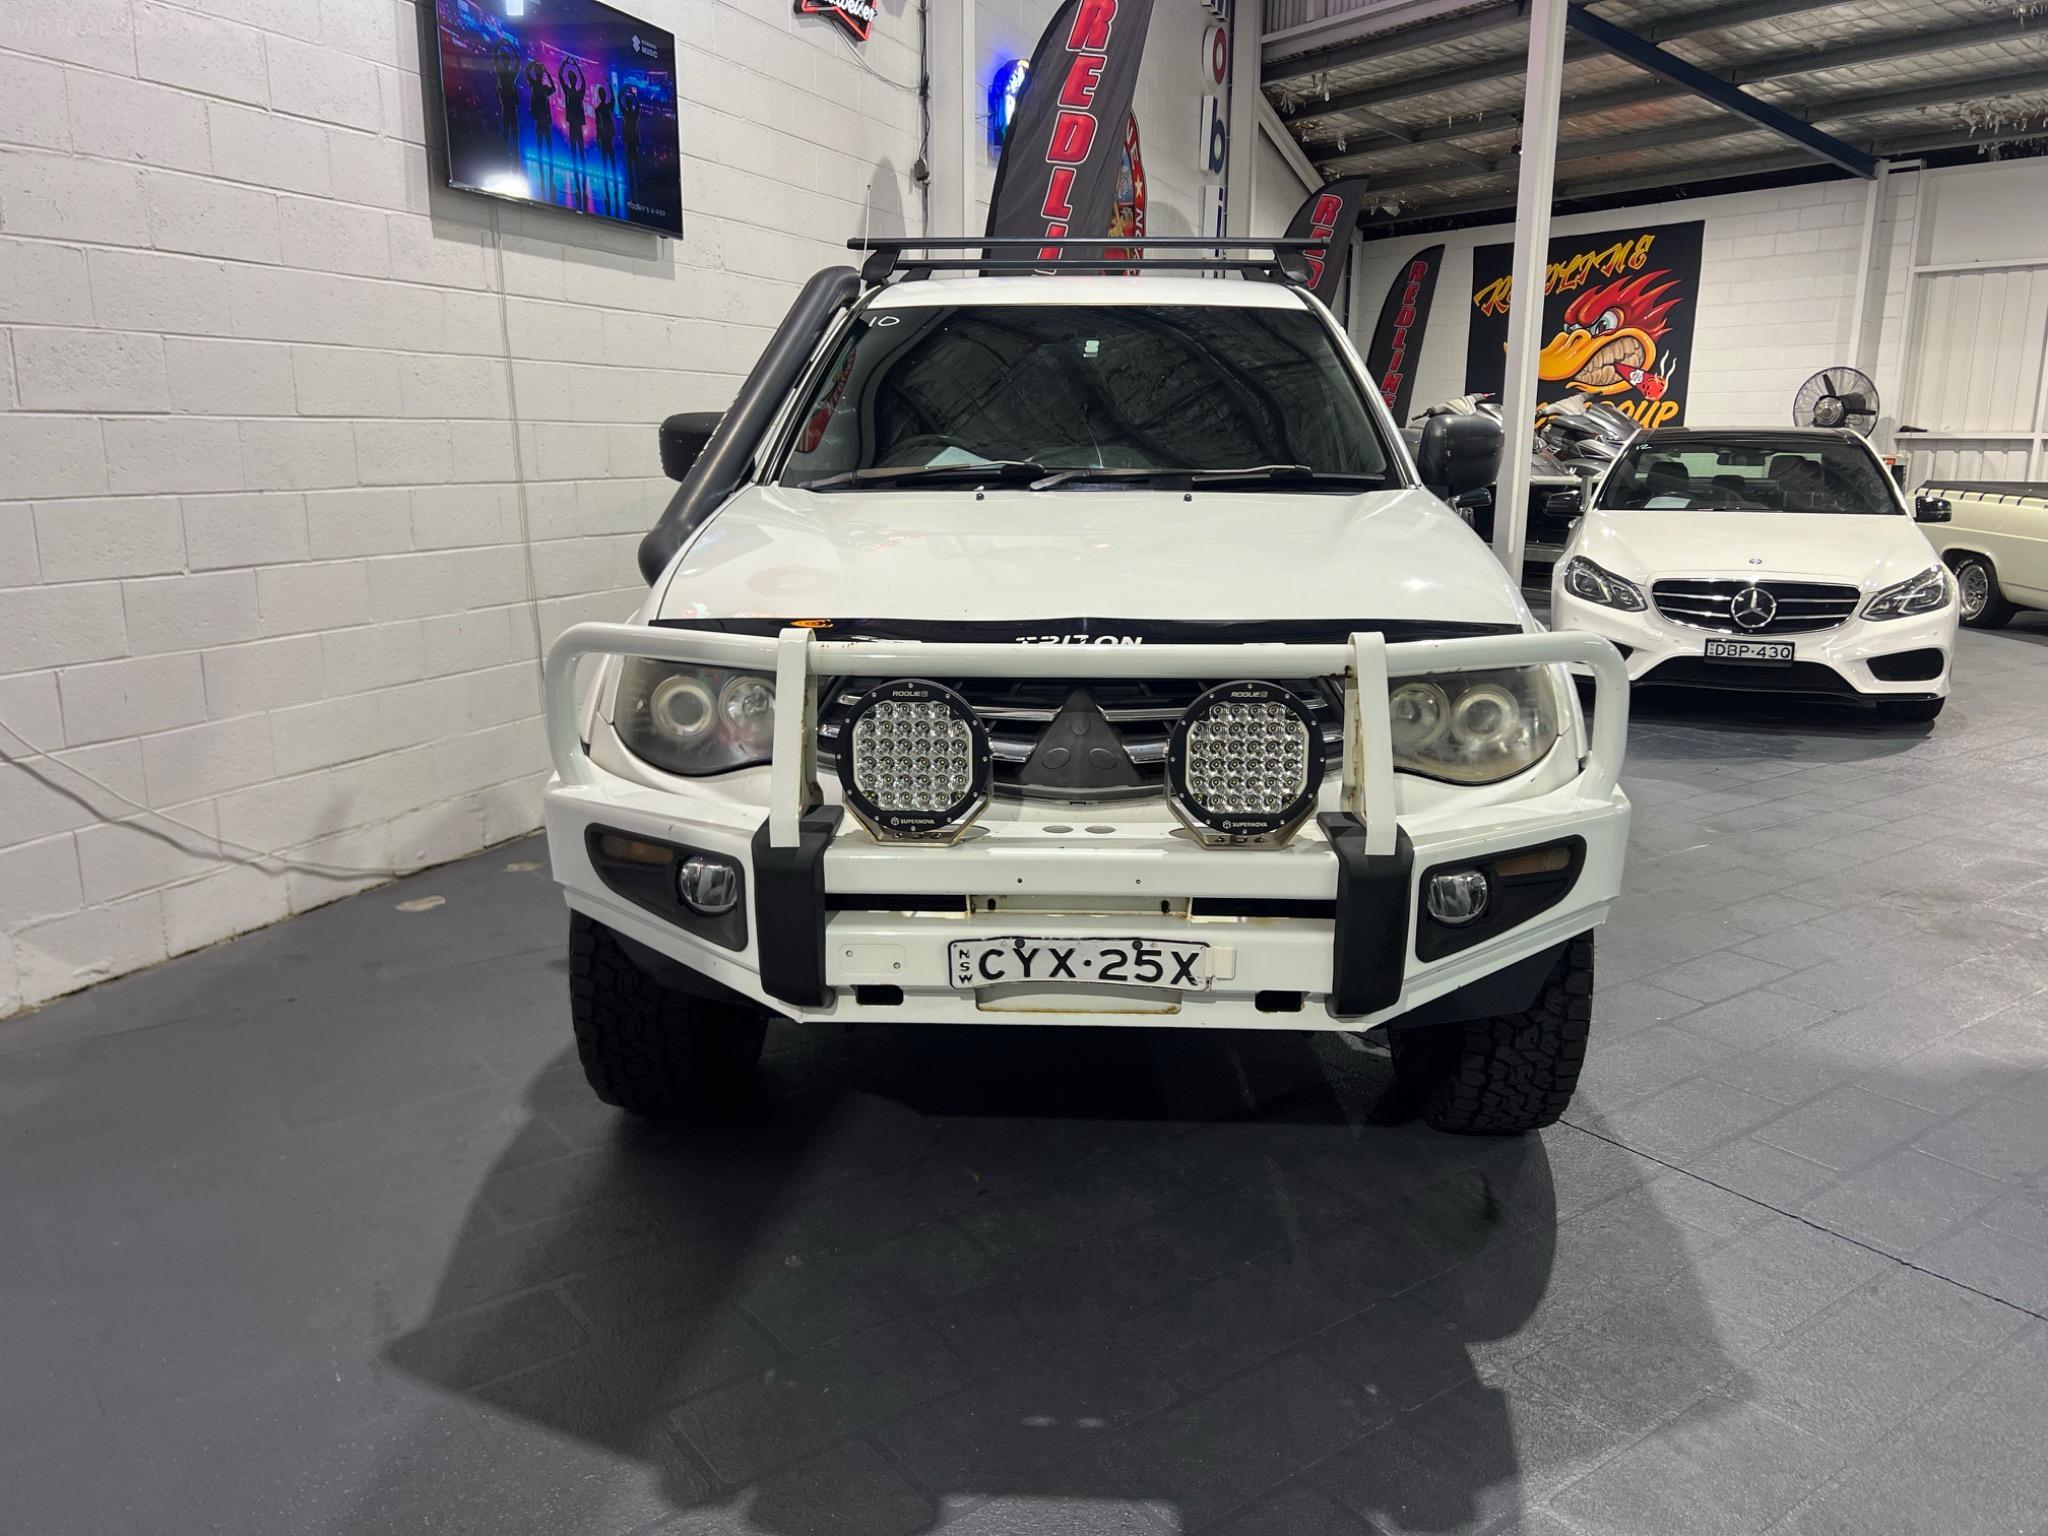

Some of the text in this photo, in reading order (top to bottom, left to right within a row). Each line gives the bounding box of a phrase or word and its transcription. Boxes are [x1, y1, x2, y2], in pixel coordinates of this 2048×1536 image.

[868, 315, 901, 327] 10
[1378, 260, 1429, 411] REDLINE
[958, 949, 973, 984] NSW
